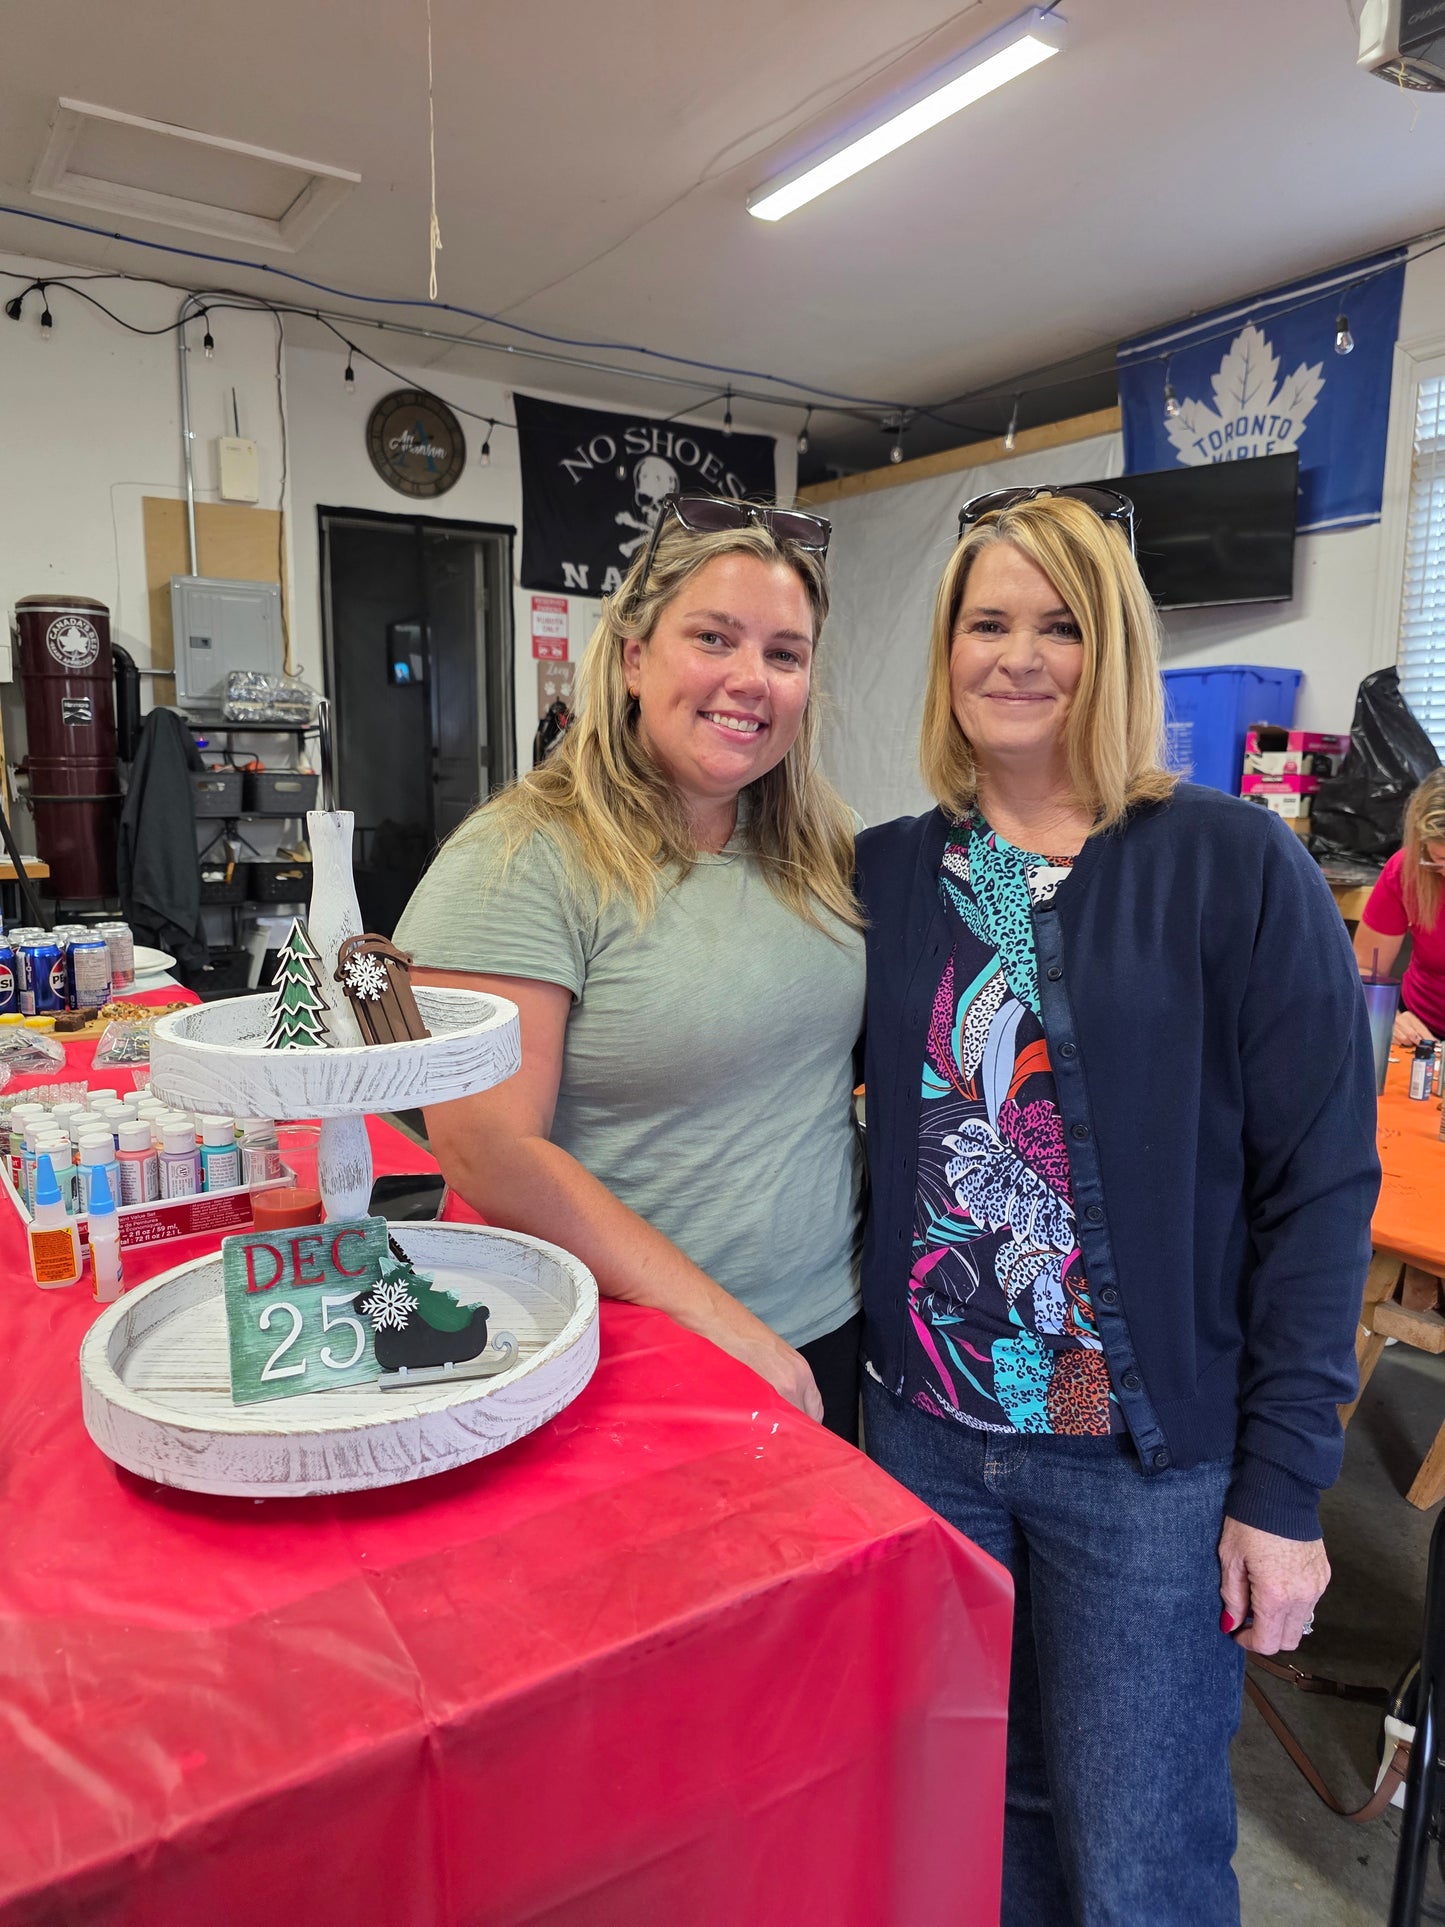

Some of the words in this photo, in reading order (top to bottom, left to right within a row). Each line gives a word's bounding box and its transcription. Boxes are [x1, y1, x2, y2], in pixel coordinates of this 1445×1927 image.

[558, 435, 617, 485] NO
[623, 427, 748, 500] SHOES
[1192, 414, 1293, 458] TORONTO
[49, 618, 90, 640] CANADA'S
[88, 631, 97, 656] BEST
[118, 1213, 130, 1222] aint
[241, 1228, 368, 1294] DEC
[258, 1290, 366, 1382] 25
